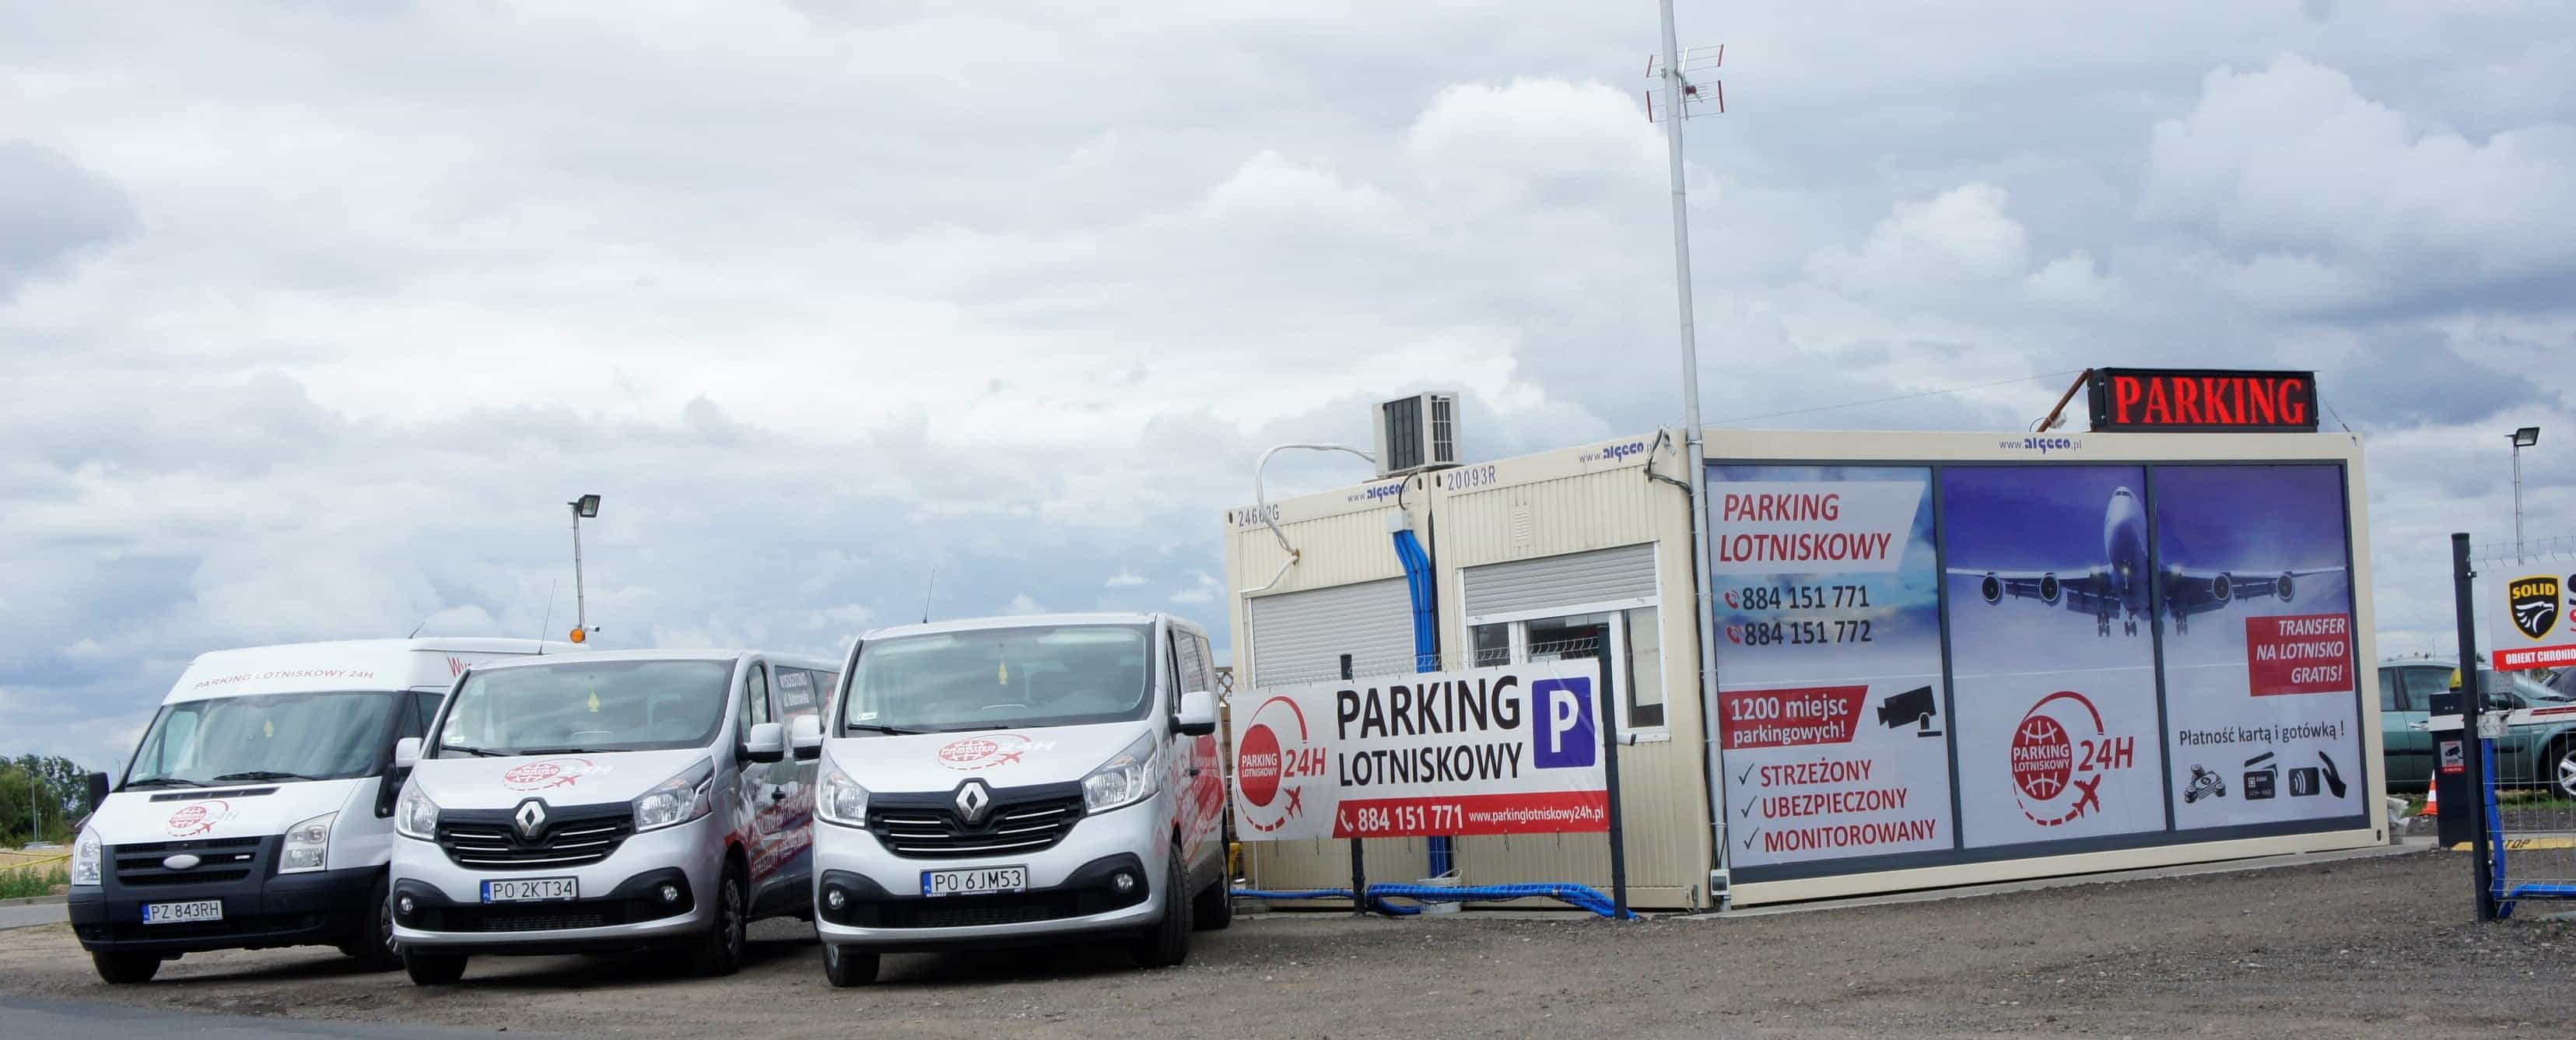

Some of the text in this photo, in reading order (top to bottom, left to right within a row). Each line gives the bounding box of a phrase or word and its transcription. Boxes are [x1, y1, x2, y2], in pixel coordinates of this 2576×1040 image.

[2114, 375, 2304, 425] PARKING
[1999, 437, 2082, 455] www.algeco.pl
[1448, 464, 1496, 492] 20093R
[1723, 493, 1840, 522] PARKING
[1719, 533, 1891, 562] LOTNISKOWY
[1742, 585, 1870, 611] 884 151 771
[2512, 583, 2556, 599] SOLID
[1744, 620, 1872, 646] 884 151 772
[2279, 618, 2346, 636] TRANSFER
[2256, 641, 2344, 660] NA LOTNISKO
[2505, 652, 2536, 665] OBIEKT
[195, 669, 374, 689] PARKING LOTNISKOWY 24H
[2291, 665, 2343, 684] GRATIS!
[1337, 674, 1520, 741] PARKING
[1730, 694, 1848, 721] 1200 miejsc
[1549, 689, 1579, 753] P
[1733, 721, 1846, 747] parkingowych!
[2179, 726, 2235, 747] Płatność
[2238, 726, 2272, 744] kartą
[2275, 724, 2279, 740] i
[2282, 721, 2336, 744] gotówką
[1242, 753, 1277, 768] PARKING
[1284, 747, 1327, 778] 24H
[1339, 741, 1523, 787] LOTNISKOWY
[2013, 744, 2070, 762] PARKING
[2013, 758, 2070, 772] LOTNISKOWY
[2078, 736, 2134, 772] 24H
[1242, 767, 1277, 778] LOTNISKOWY
[1760, 756, 1872, 787] STRZEŻONY
[1763, 788, 1908, 818] UBEZPIECZONY
[1358, 804, 1604, 832] 884 151 771 www.parkinglotniskowy24h.pl
[1765, 819, 1936, 853] MONITOROWANY
[2506, 839, 2532, 849] TOP
[493, 881, 573, 898] PO 2KT34
[934, 870, 1022, 891] PO 6JM53
[151, 902, 219, 920] PZ 843RH
